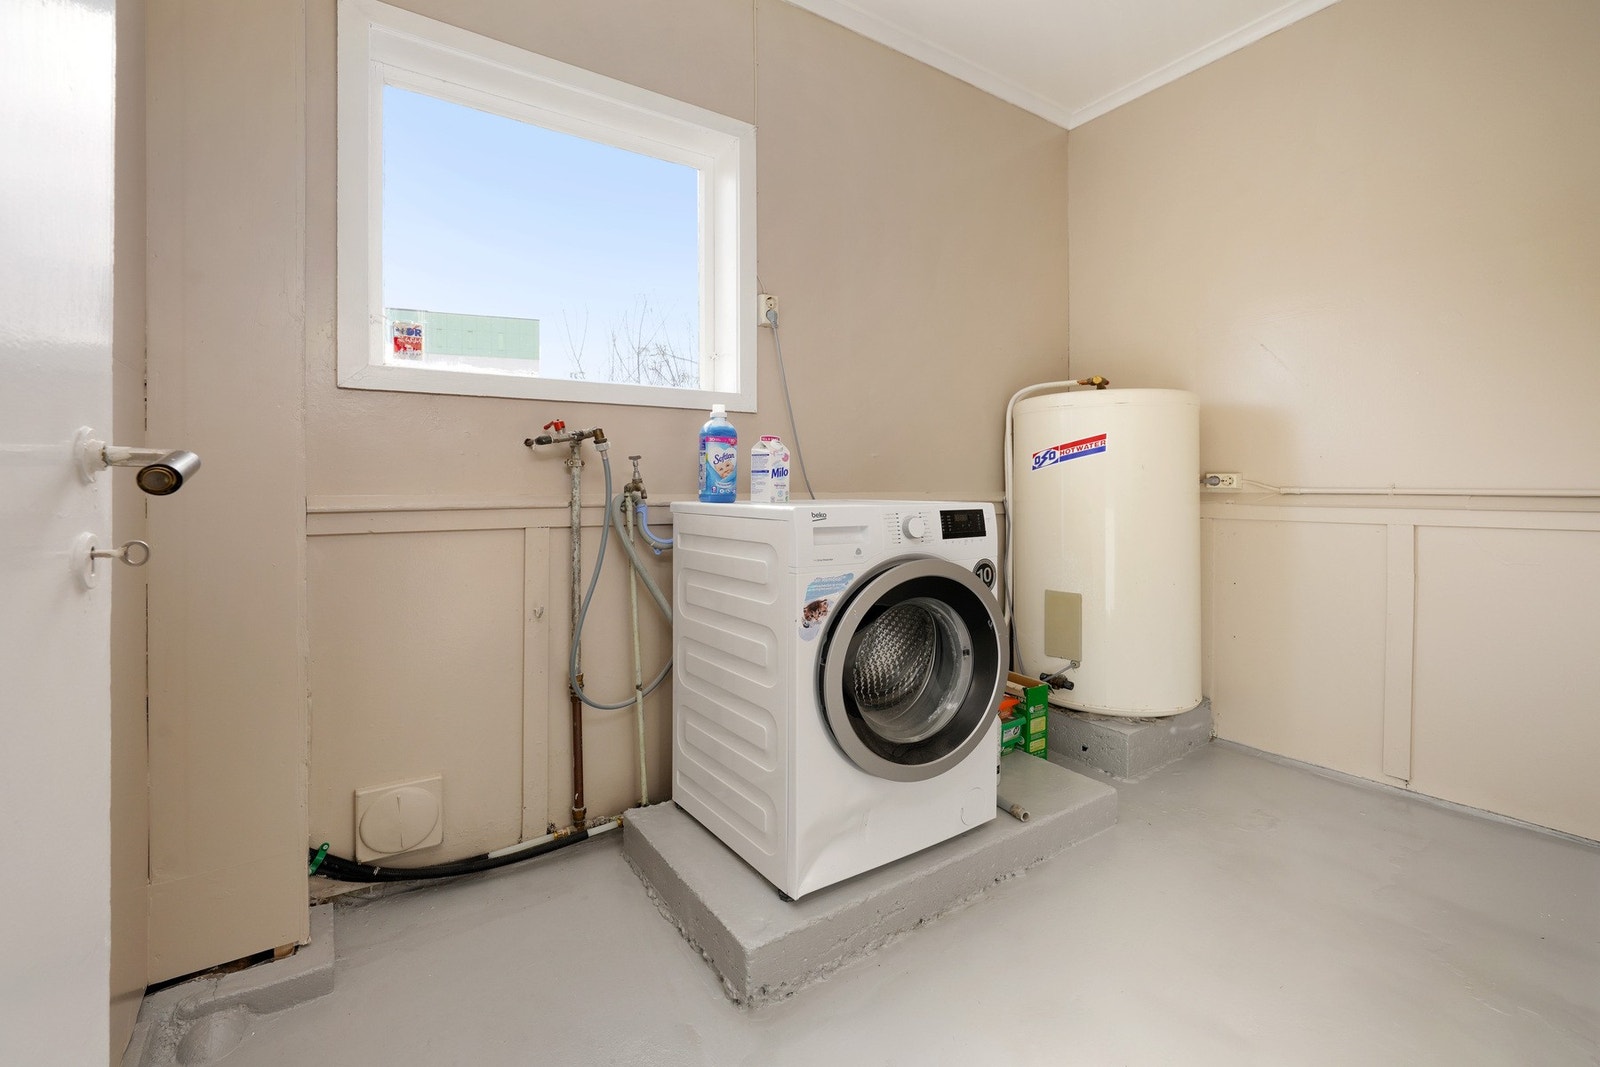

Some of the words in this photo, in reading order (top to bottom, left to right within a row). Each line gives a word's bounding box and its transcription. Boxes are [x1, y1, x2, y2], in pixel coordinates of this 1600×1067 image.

[713, 452, 735, 465] Softlan
[1034, 450, 1056, 467] OSO
[771, 467, 789, 479] Milo
[977, 567, 992, 583] 10
